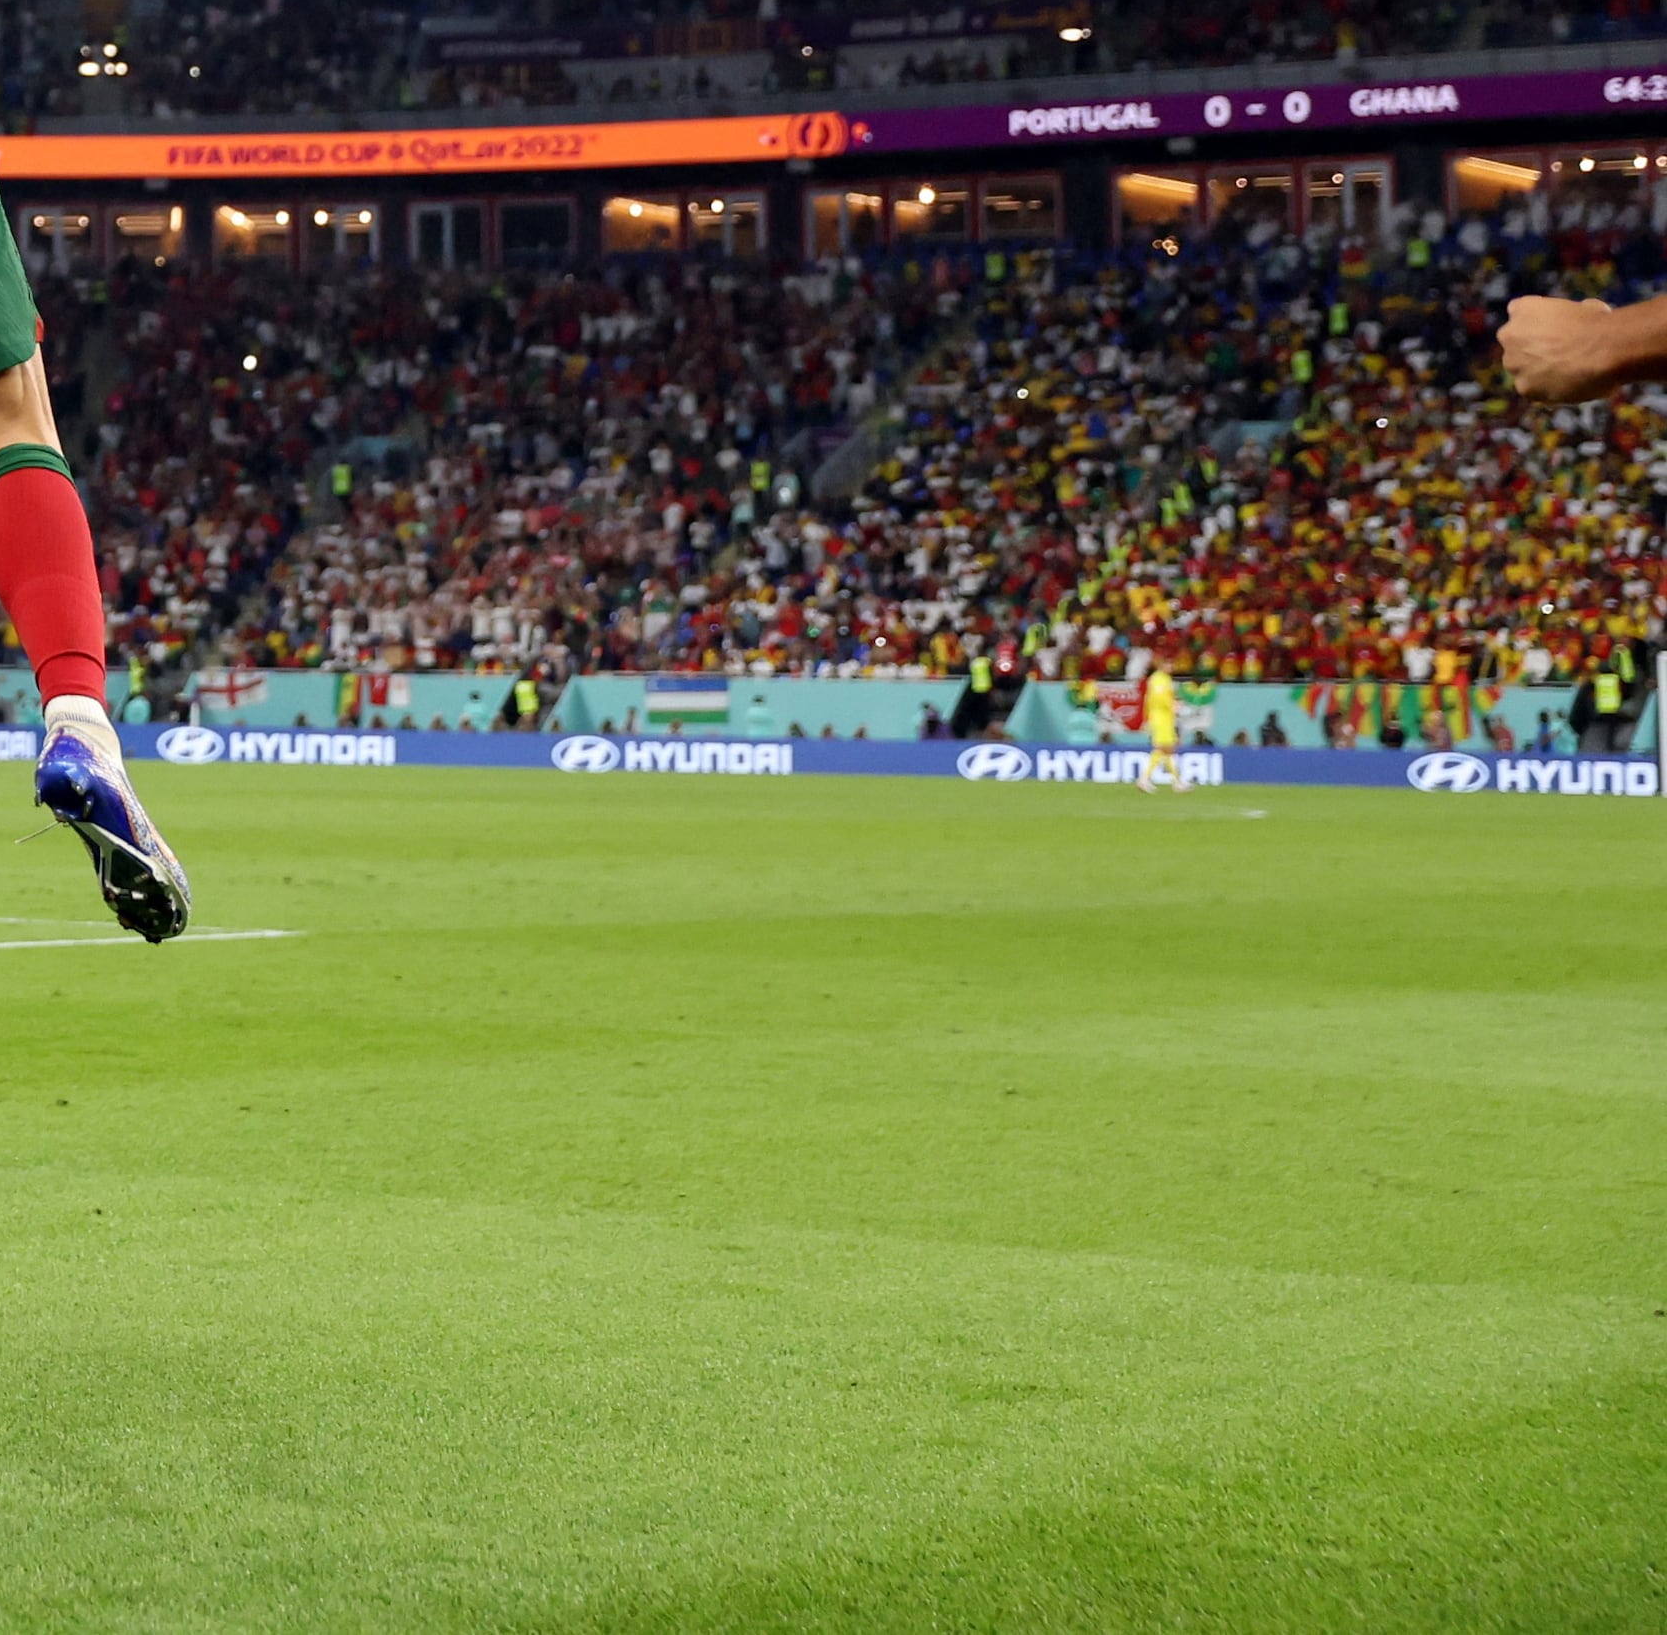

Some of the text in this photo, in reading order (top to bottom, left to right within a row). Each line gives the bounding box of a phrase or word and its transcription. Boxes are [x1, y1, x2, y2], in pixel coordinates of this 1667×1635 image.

[1008, 102, 1160, 137] PORTUGAL
[1204, 95, 1231, 128] 0
[1283, 91, 1311, 123] 0
[1349, 84, 1460, 118] GHANA
[1603, 74, 1667, 103] 64:2
[168, 145, 224, 166] FIFA
[229, 143, 326, 165] WORLD
[331, 141, 381, 164] CUP
[230, 732, 396, 767] HYUNDAI
[624, 740, 793, 775] HYUNDAI
[1496, 758, 1660, 797] HYUND
